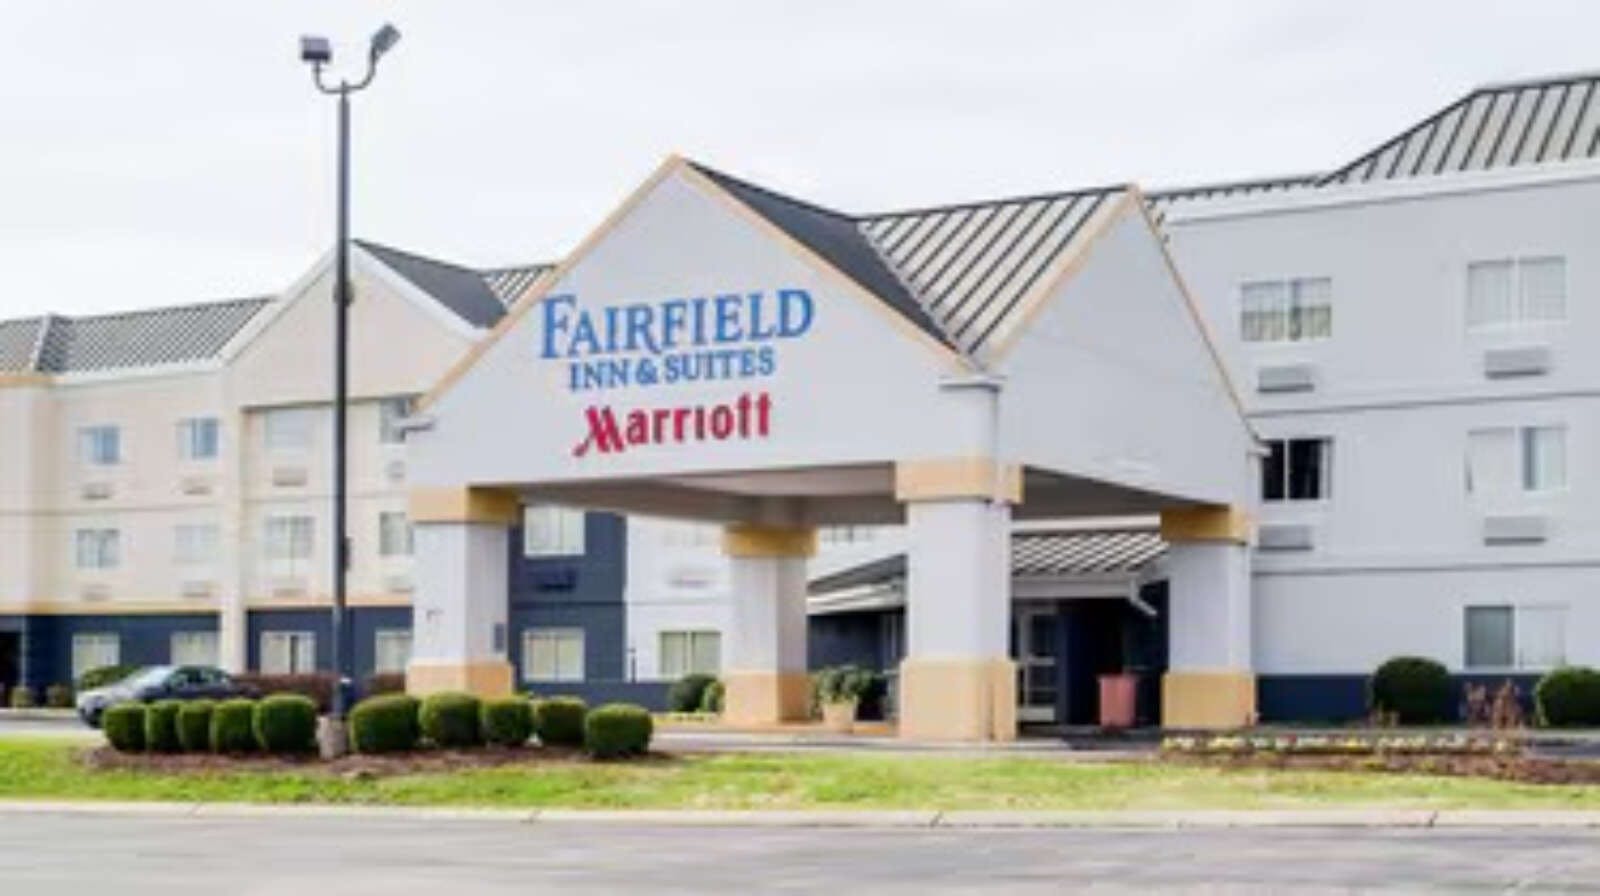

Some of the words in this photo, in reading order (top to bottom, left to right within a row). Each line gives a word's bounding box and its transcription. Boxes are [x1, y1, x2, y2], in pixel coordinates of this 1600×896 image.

[540, 288, 815, 359] FAIRFIELD
[569, 357, 629, 391] INN
[635, 356, 658, 385] &
[664, 346, 776, 383] SUITES
[573, 391, 772, 457] Marriott
